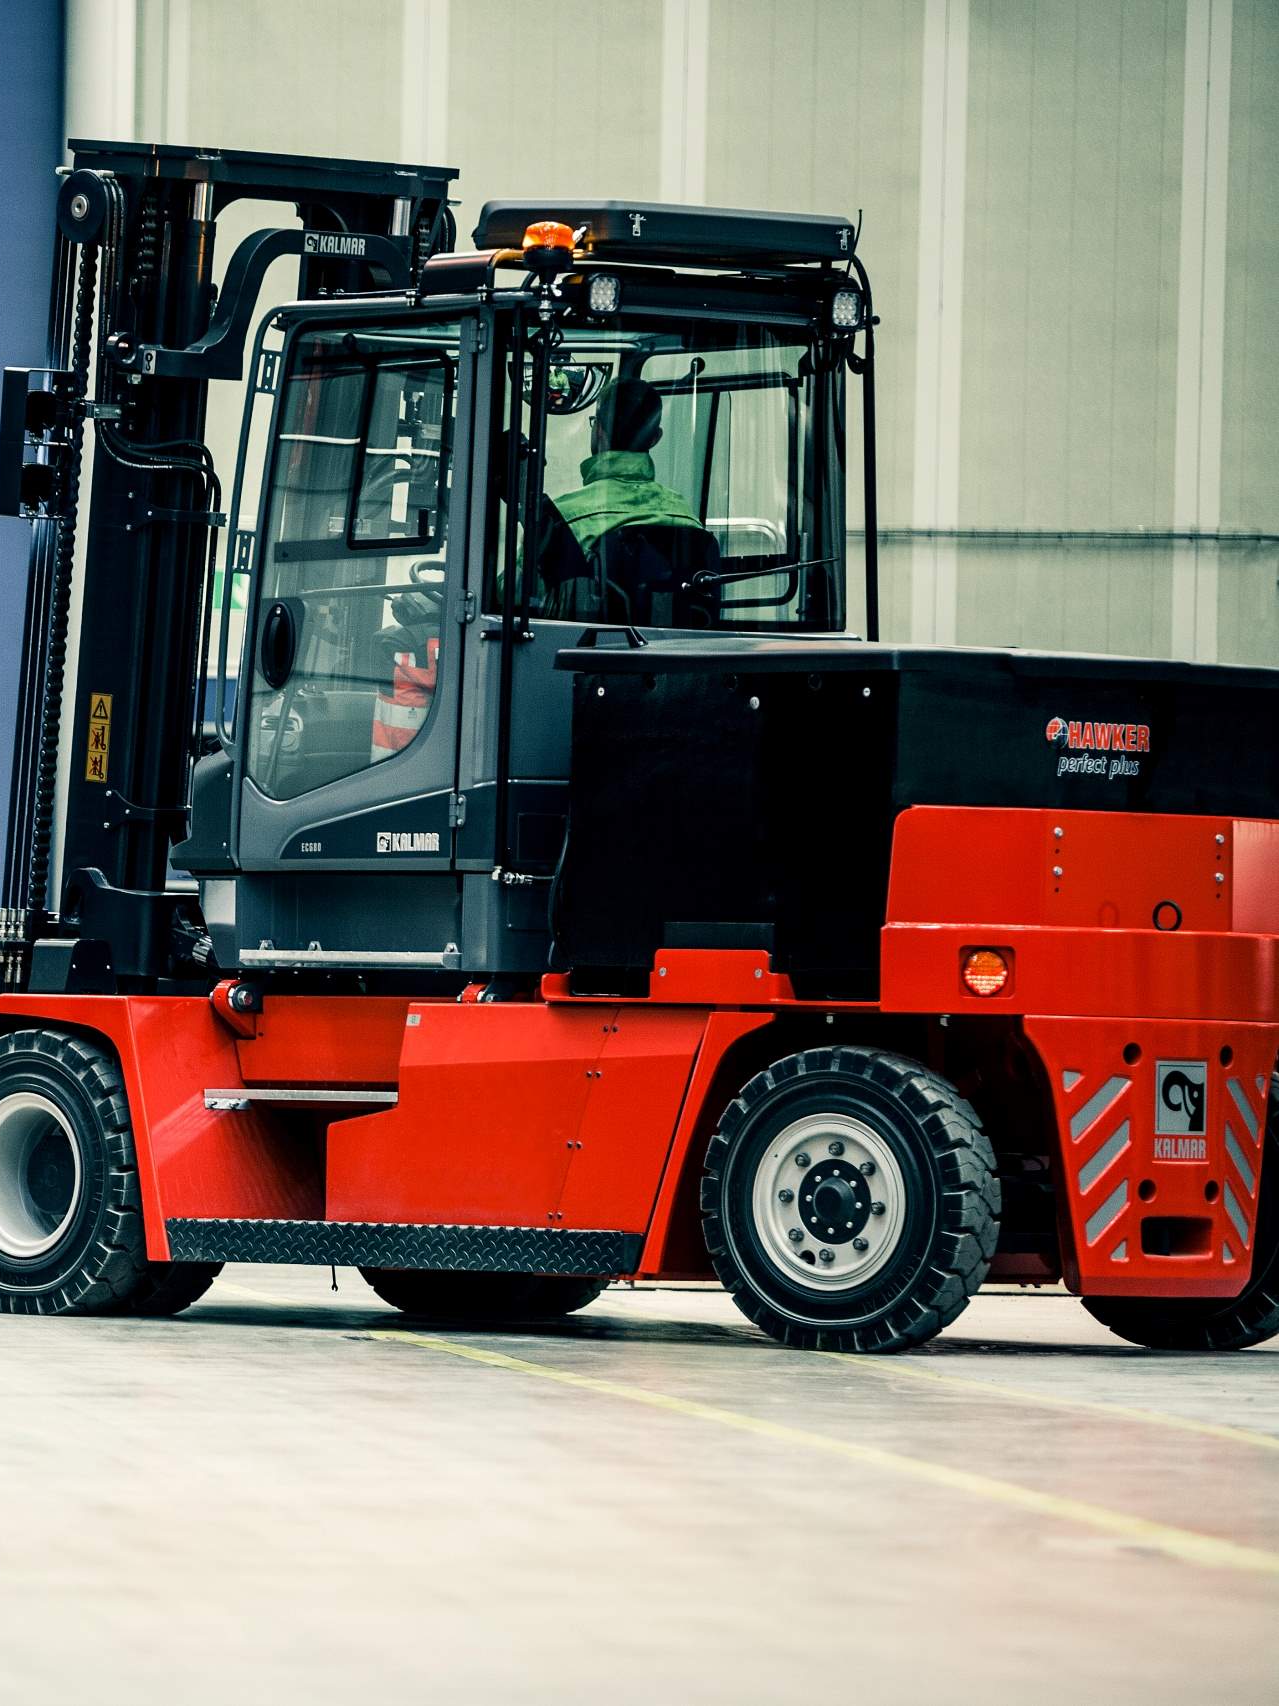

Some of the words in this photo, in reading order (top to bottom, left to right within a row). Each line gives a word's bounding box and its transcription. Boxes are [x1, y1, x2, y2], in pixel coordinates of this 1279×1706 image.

[319, 235, 366, 256] KALMAR
[1068, 721, 1150, 752] HAWKER
[1057, 753, 1108, 777] perfect
[1108, 754, 1140, 780] plus
[392, 832, 440, 852] KALMAR
[1154, 1138, 1206, 1159] KALMAR
